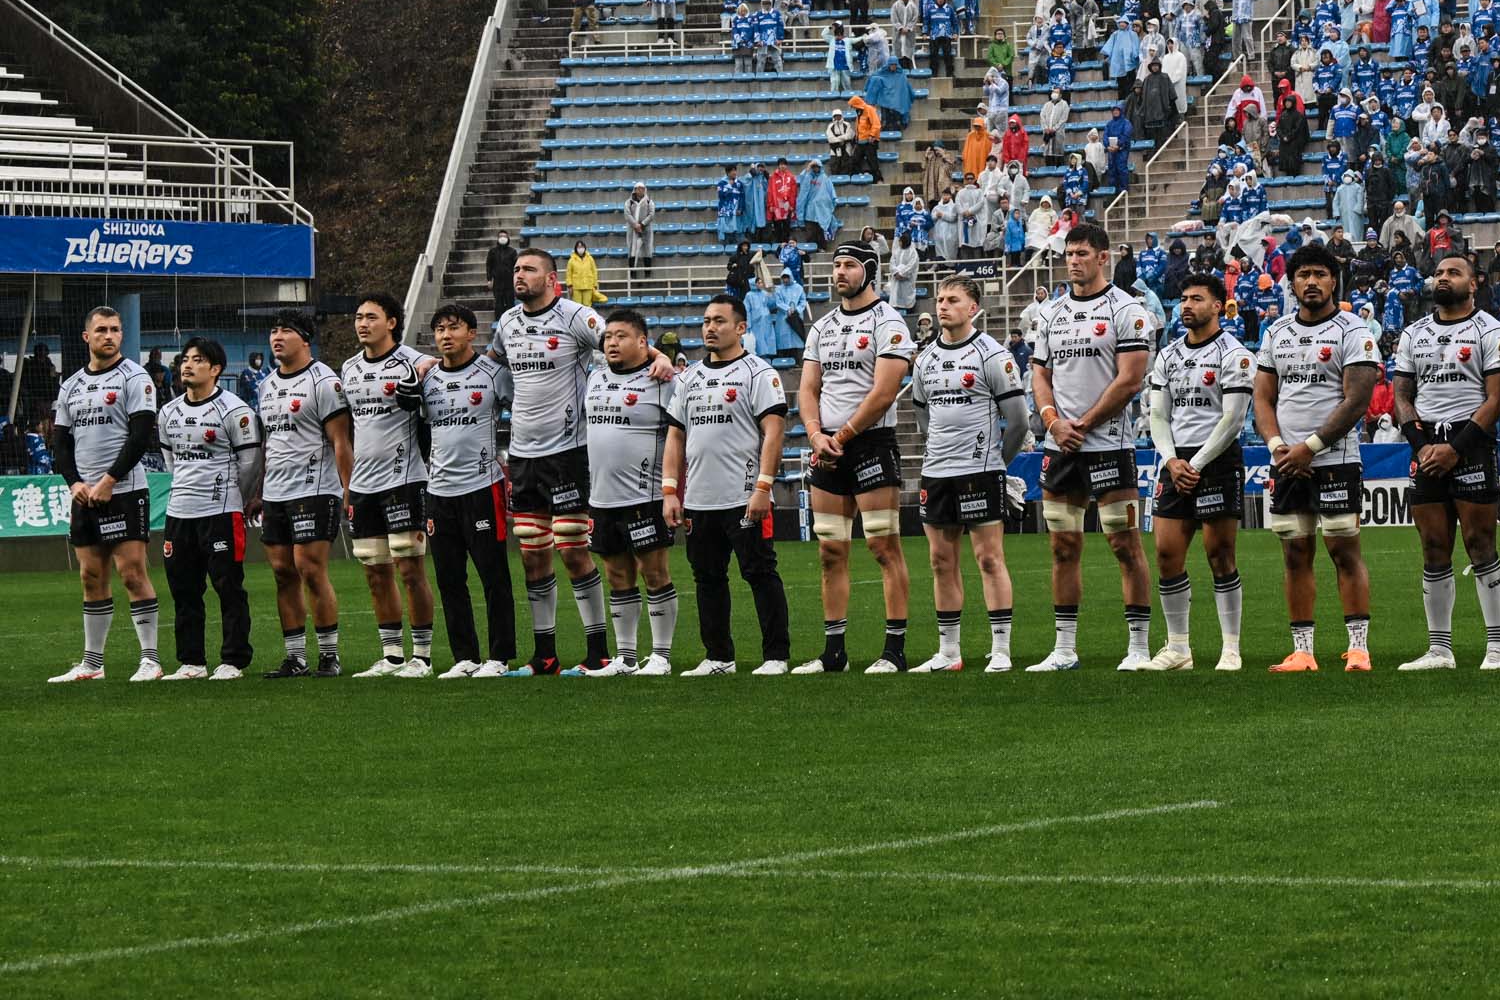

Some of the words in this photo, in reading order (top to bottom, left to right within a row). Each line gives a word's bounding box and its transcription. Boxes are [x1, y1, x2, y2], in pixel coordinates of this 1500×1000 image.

[103, 223, 165, 236] SHIZUOKA
[63, 228, 194, 269] BlueRevs
[975, 265, 994, 275] 466
[1053, 347, 1102, 360] TOSHIBA
[511, 361, 556, 371] TOSHIBA
[822, 361, 863, 371] TOSHIBA
[1281, 373, 1327, 383] TOSHIBA
[1422, 373, 1467, 383] TOSHIBA
[588, 415, 631, 426] TOSHIBA
[690, 415, 733, 425] TOSHIBA
